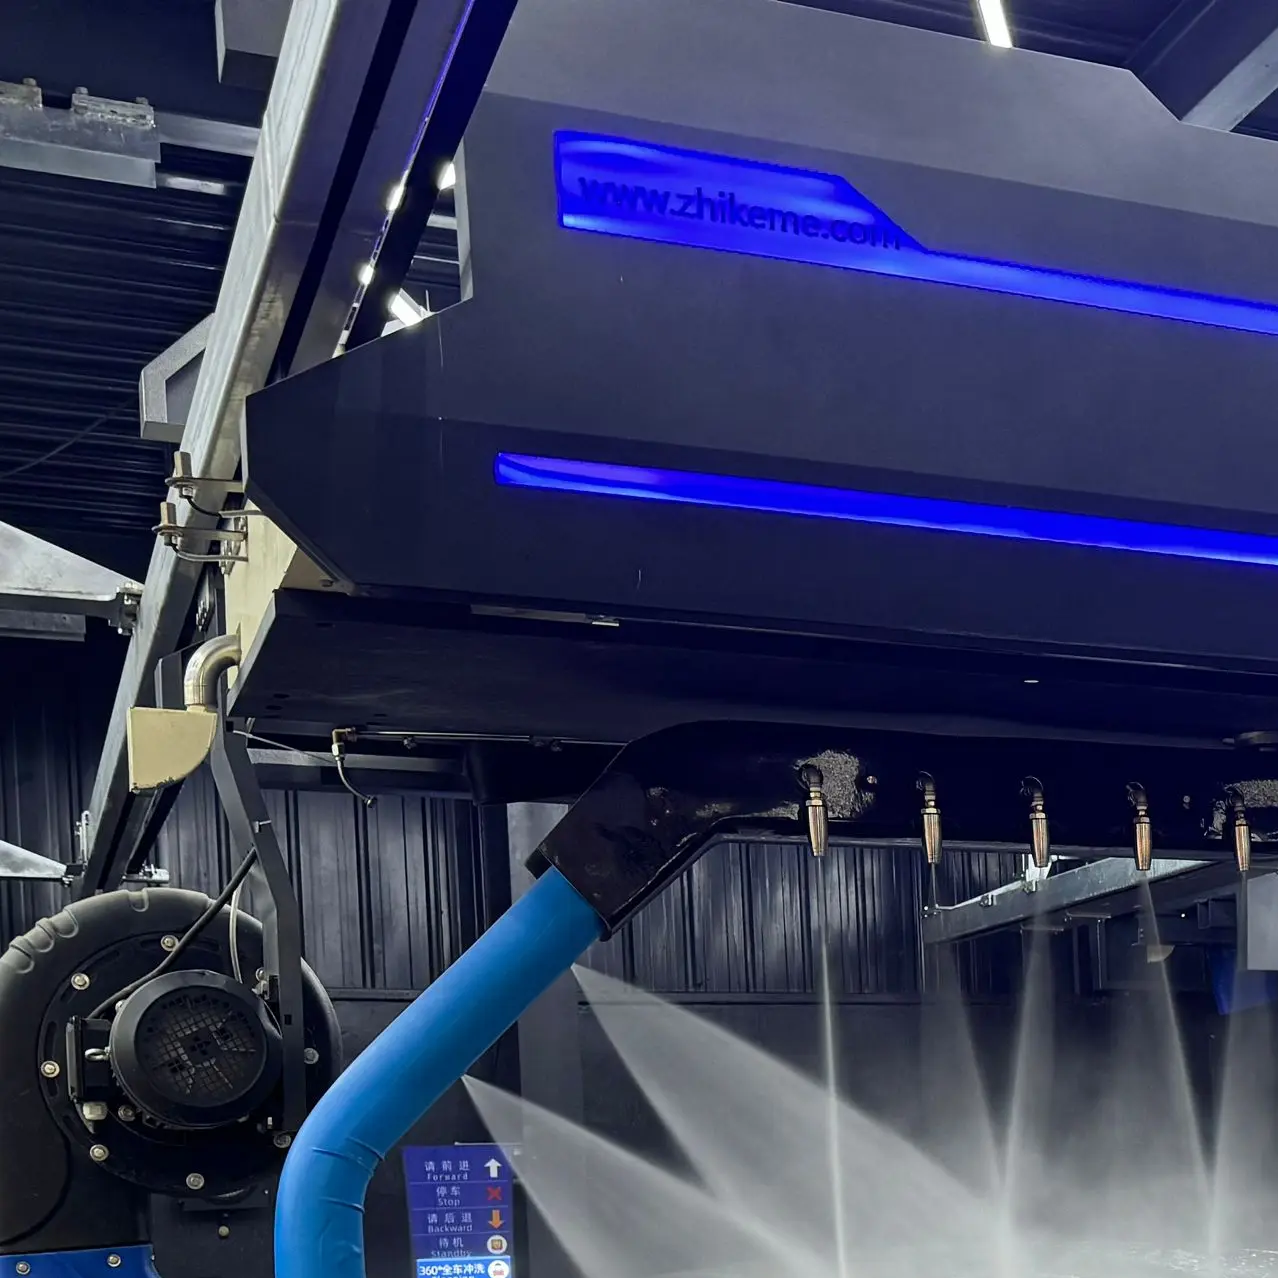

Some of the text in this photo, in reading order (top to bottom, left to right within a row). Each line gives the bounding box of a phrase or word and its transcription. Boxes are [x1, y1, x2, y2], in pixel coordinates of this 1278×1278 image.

[577, 176, 901, 251] www.zhikeme.com
[424, 1160, 471, 1173] 请前进
[427, 1172, 469, 1181] Forward
[436, 1185, 461, 1197] 停车
[437, 1198, 461, 1207] Stop
[427, 1212, 473, 1224] 请后退
[427, 1224, 473, 1234] Backward
[439, 1237, 464, 1249] 待机
[430, 1249, 473, 1258] Standby
[419, 1263, 486, 1276] 360°全车冲洗
